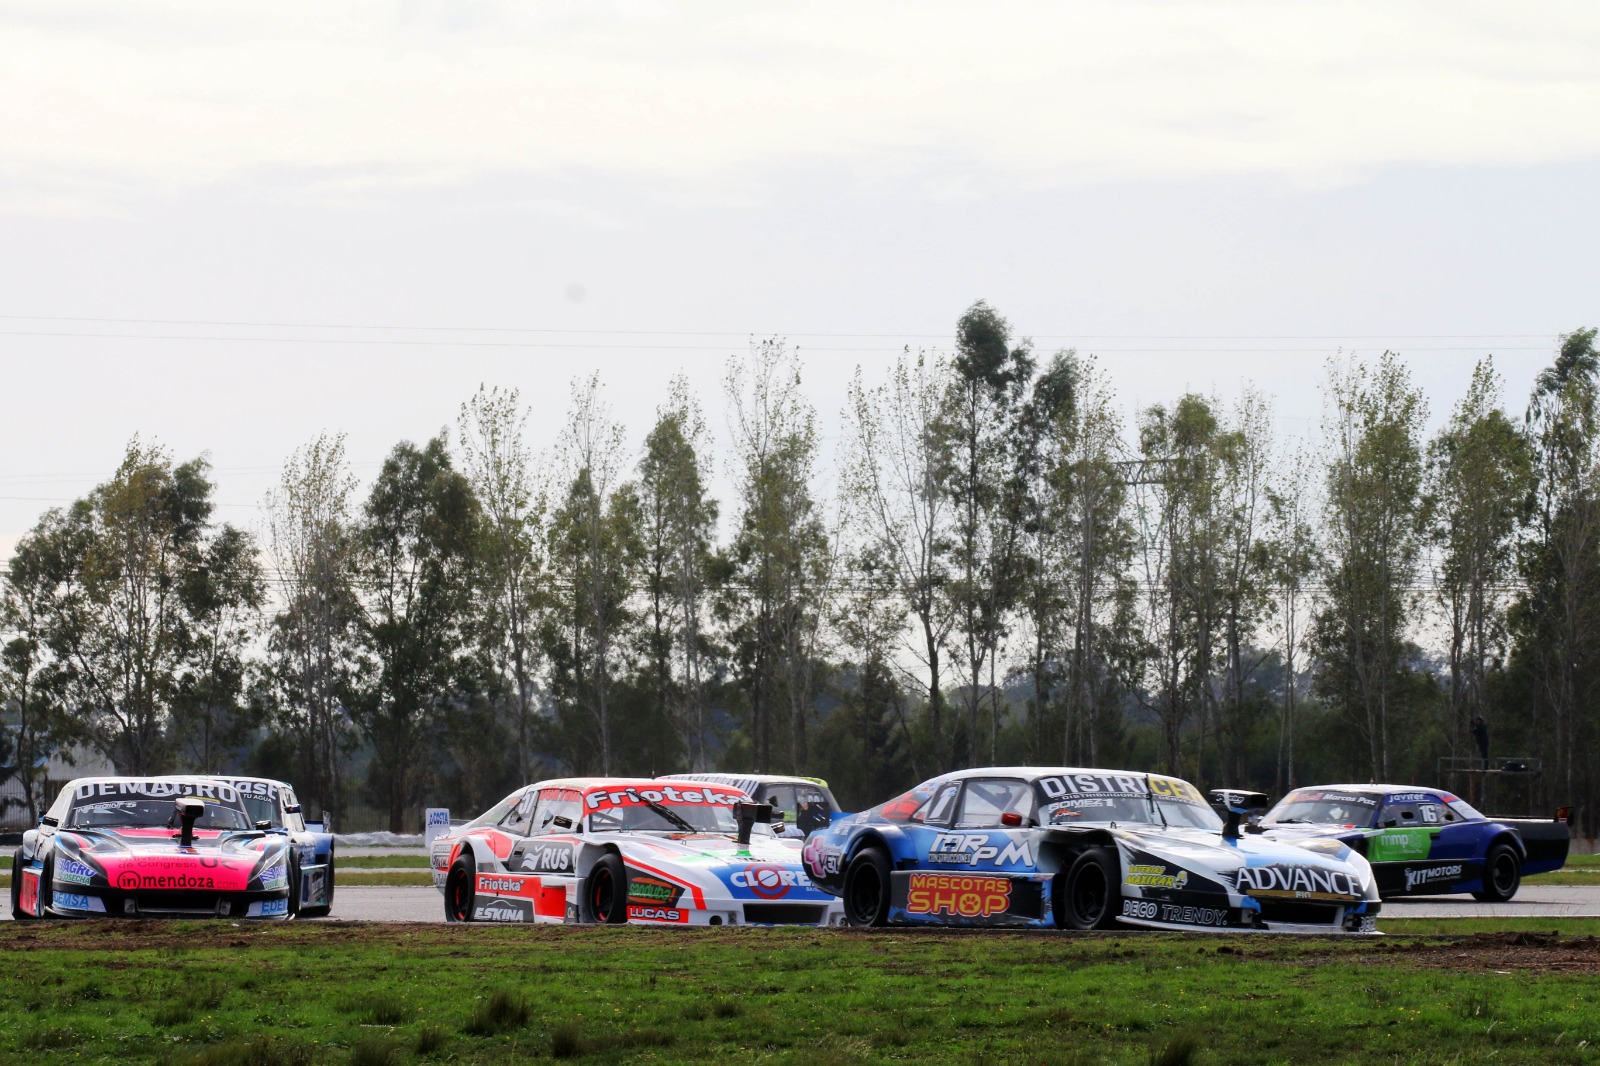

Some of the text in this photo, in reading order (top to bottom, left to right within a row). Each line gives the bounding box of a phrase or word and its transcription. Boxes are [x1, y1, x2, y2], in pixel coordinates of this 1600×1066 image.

[77, 782, 237, 803] DEMAGRO
[254, 794, 272, 803] AGUA
[585, 786, 744, 809] Frioteka
[1322, 793, 1357, 802] Marcos
[1357, 796, 1377, 806] Paz
[1420, 804, 1438, 822] 16
[1381, 834, 1409, 848] mmp
[137, 861, 198, 869] Congreso
[540, 848, 571, 870] RUS
[478, 877, 522, 892] Frioteka
[730, 869, 814, 888] CLORE
[911, 876, 1008, 893] MASCOTAS
[1125, 875, 1176, 888] MAXIKAR
[1235, 867, 1362, 897] ADVANCE
[909, 891, 1006, 915] SHOP
[1122, 900, 1157, 919] DECO
[473, 906, 524, 921] ESKINA
[630, 907, 680, 920] LUCAS
